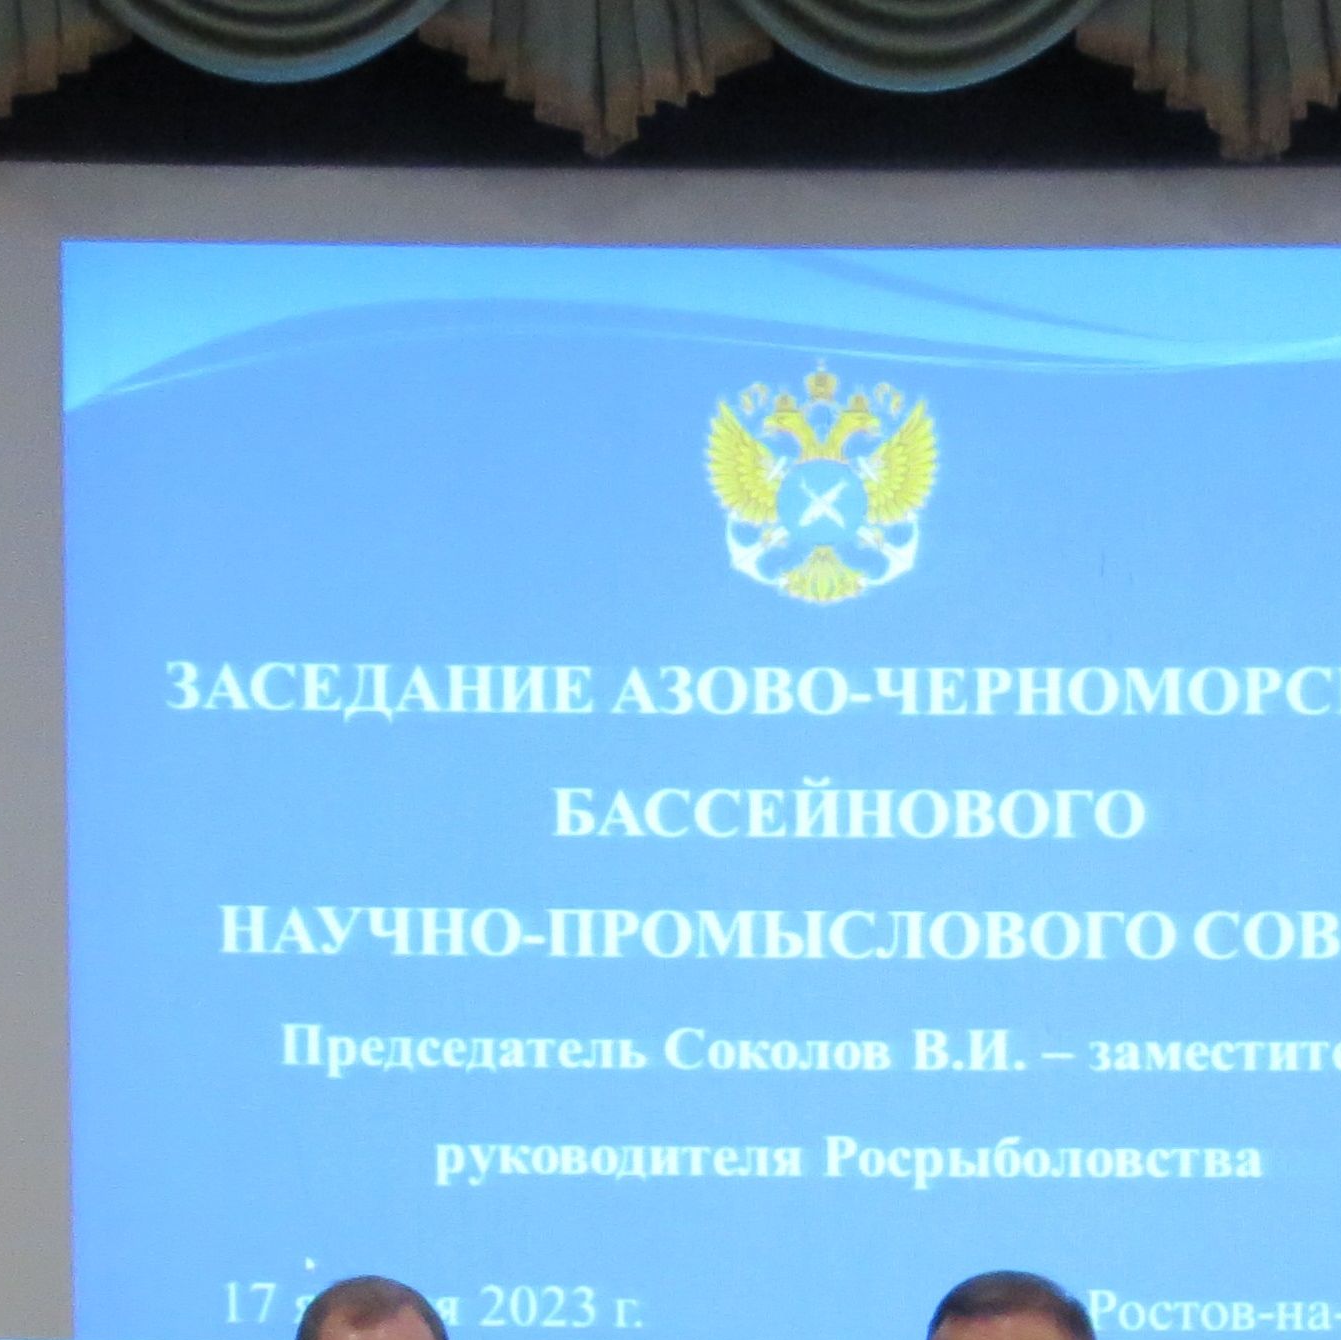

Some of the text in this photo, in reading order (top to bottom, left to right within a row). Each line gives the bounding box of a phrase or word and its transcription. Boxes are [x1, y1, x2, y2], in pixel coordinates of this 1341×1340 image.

[164, 660, 594, 723] ЗАСЕДАНИЕ
[555, 775, 1148, 840] БАССЕЙНОВОГО
[221, 904, 1179, 962] НАУЧНО-ПРОМЫСЛОВОГО
[282, 1022, 651, 1080] Председатель
[663, 1026, 894, 1073] Соколов
[913, 1027, 1028, 1073] В.И.
[435, 1134, 1265, 1192] руководителя Росрыболовства
[225, 1280, 279, 1325] 17
[478, 1282, 598, 1330] 2023
[614, 1296, 644, 1330] г.
